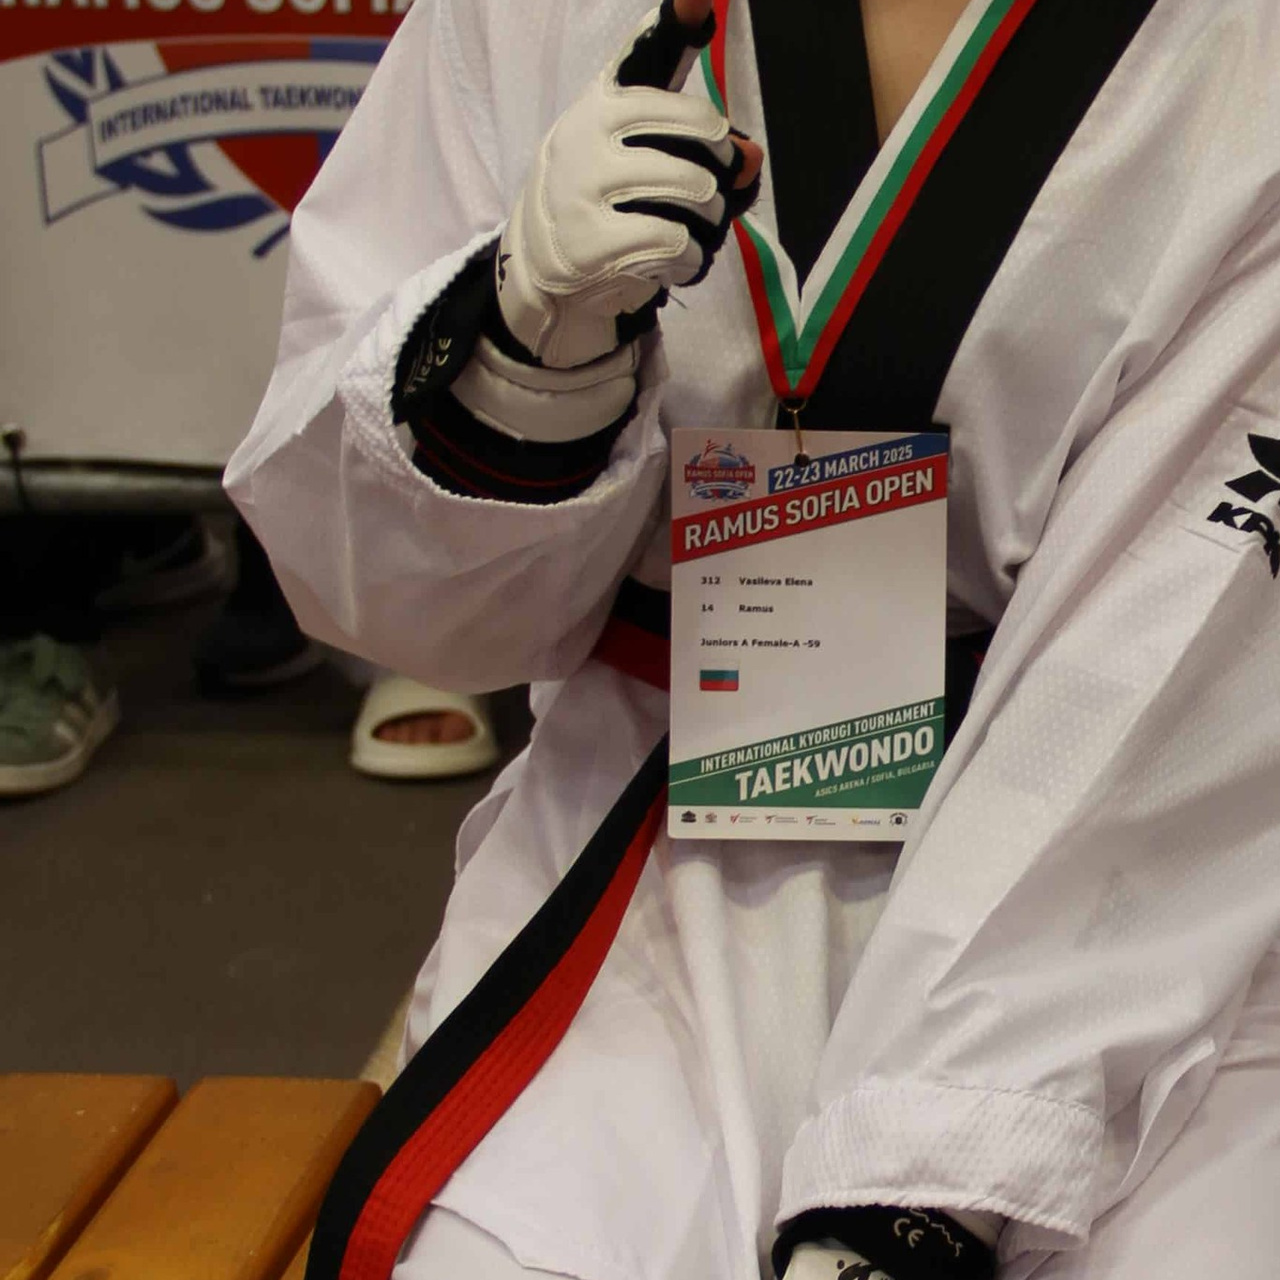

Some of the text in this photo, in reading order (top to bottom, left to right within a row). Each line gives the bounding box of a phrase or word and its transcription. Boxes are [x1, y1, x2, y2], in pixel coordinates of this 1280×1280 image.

[101, 89, 252, 143] INTERNATIONAL
[774, 444, 913, 492] 22-23 MARCH 2025
[684, 466, 934, 551] RAMUS SOFIA OPEN
[701, 576, 721, 585] 312
[785, 578, 813, 587] Elena
[739, 604, 774, 613] Ramus
[700, 638, 738, 647] Juniors
[741, 639, 749, 647] A
[752, 638, 800, 648] Female-A
[700, 701, 937, 773] INTERNATIONAL KYORUGI TOURNAMENT
[735, 725, 934, 801] TAEKWONDO
[839, 778, 865, 792] ARENA
